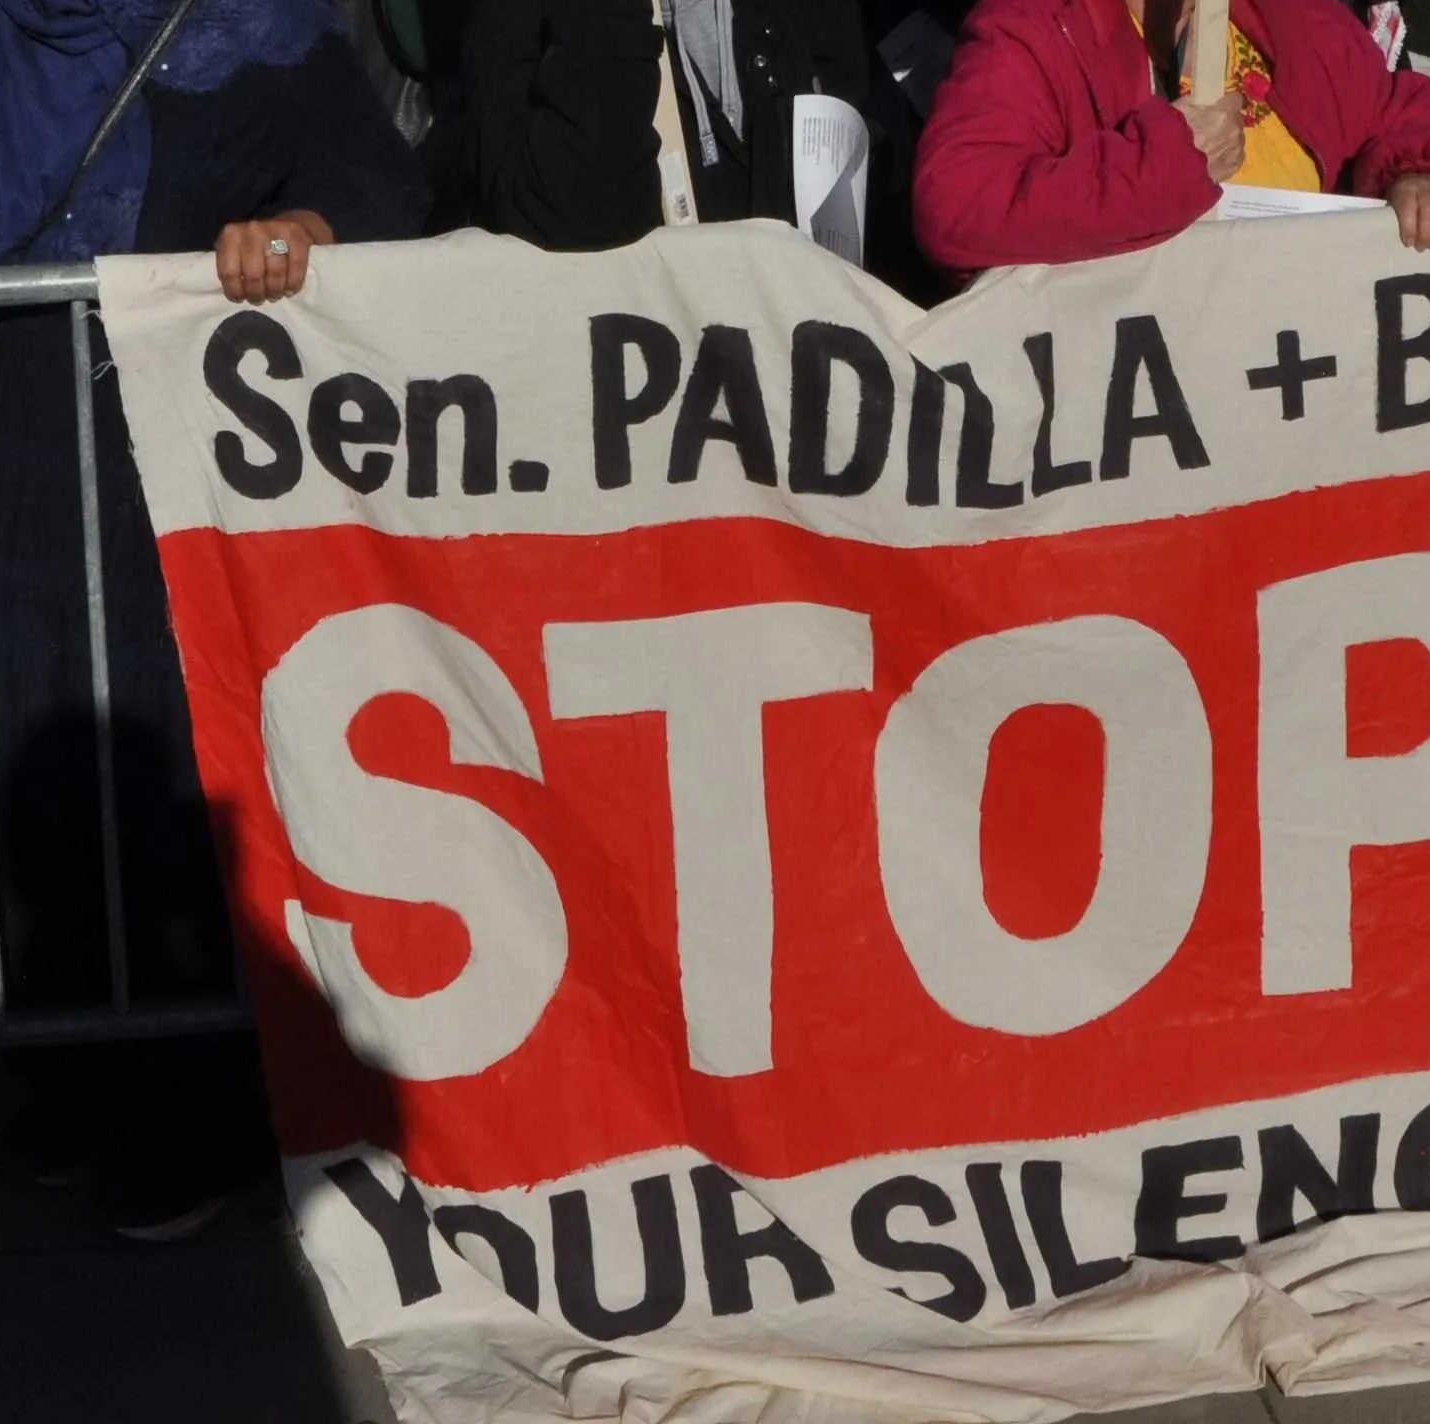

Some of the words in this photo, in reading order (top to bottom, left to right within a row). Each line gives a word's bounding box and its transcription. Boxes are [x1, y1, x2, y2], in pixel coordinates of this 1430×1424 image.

[202, 308, 550, 500] Sen.
[588, 311, 1212, 510] PADILLA
[1247, 329, 1338, 422] +
[324, 1157, 836, 1342] YOUR
